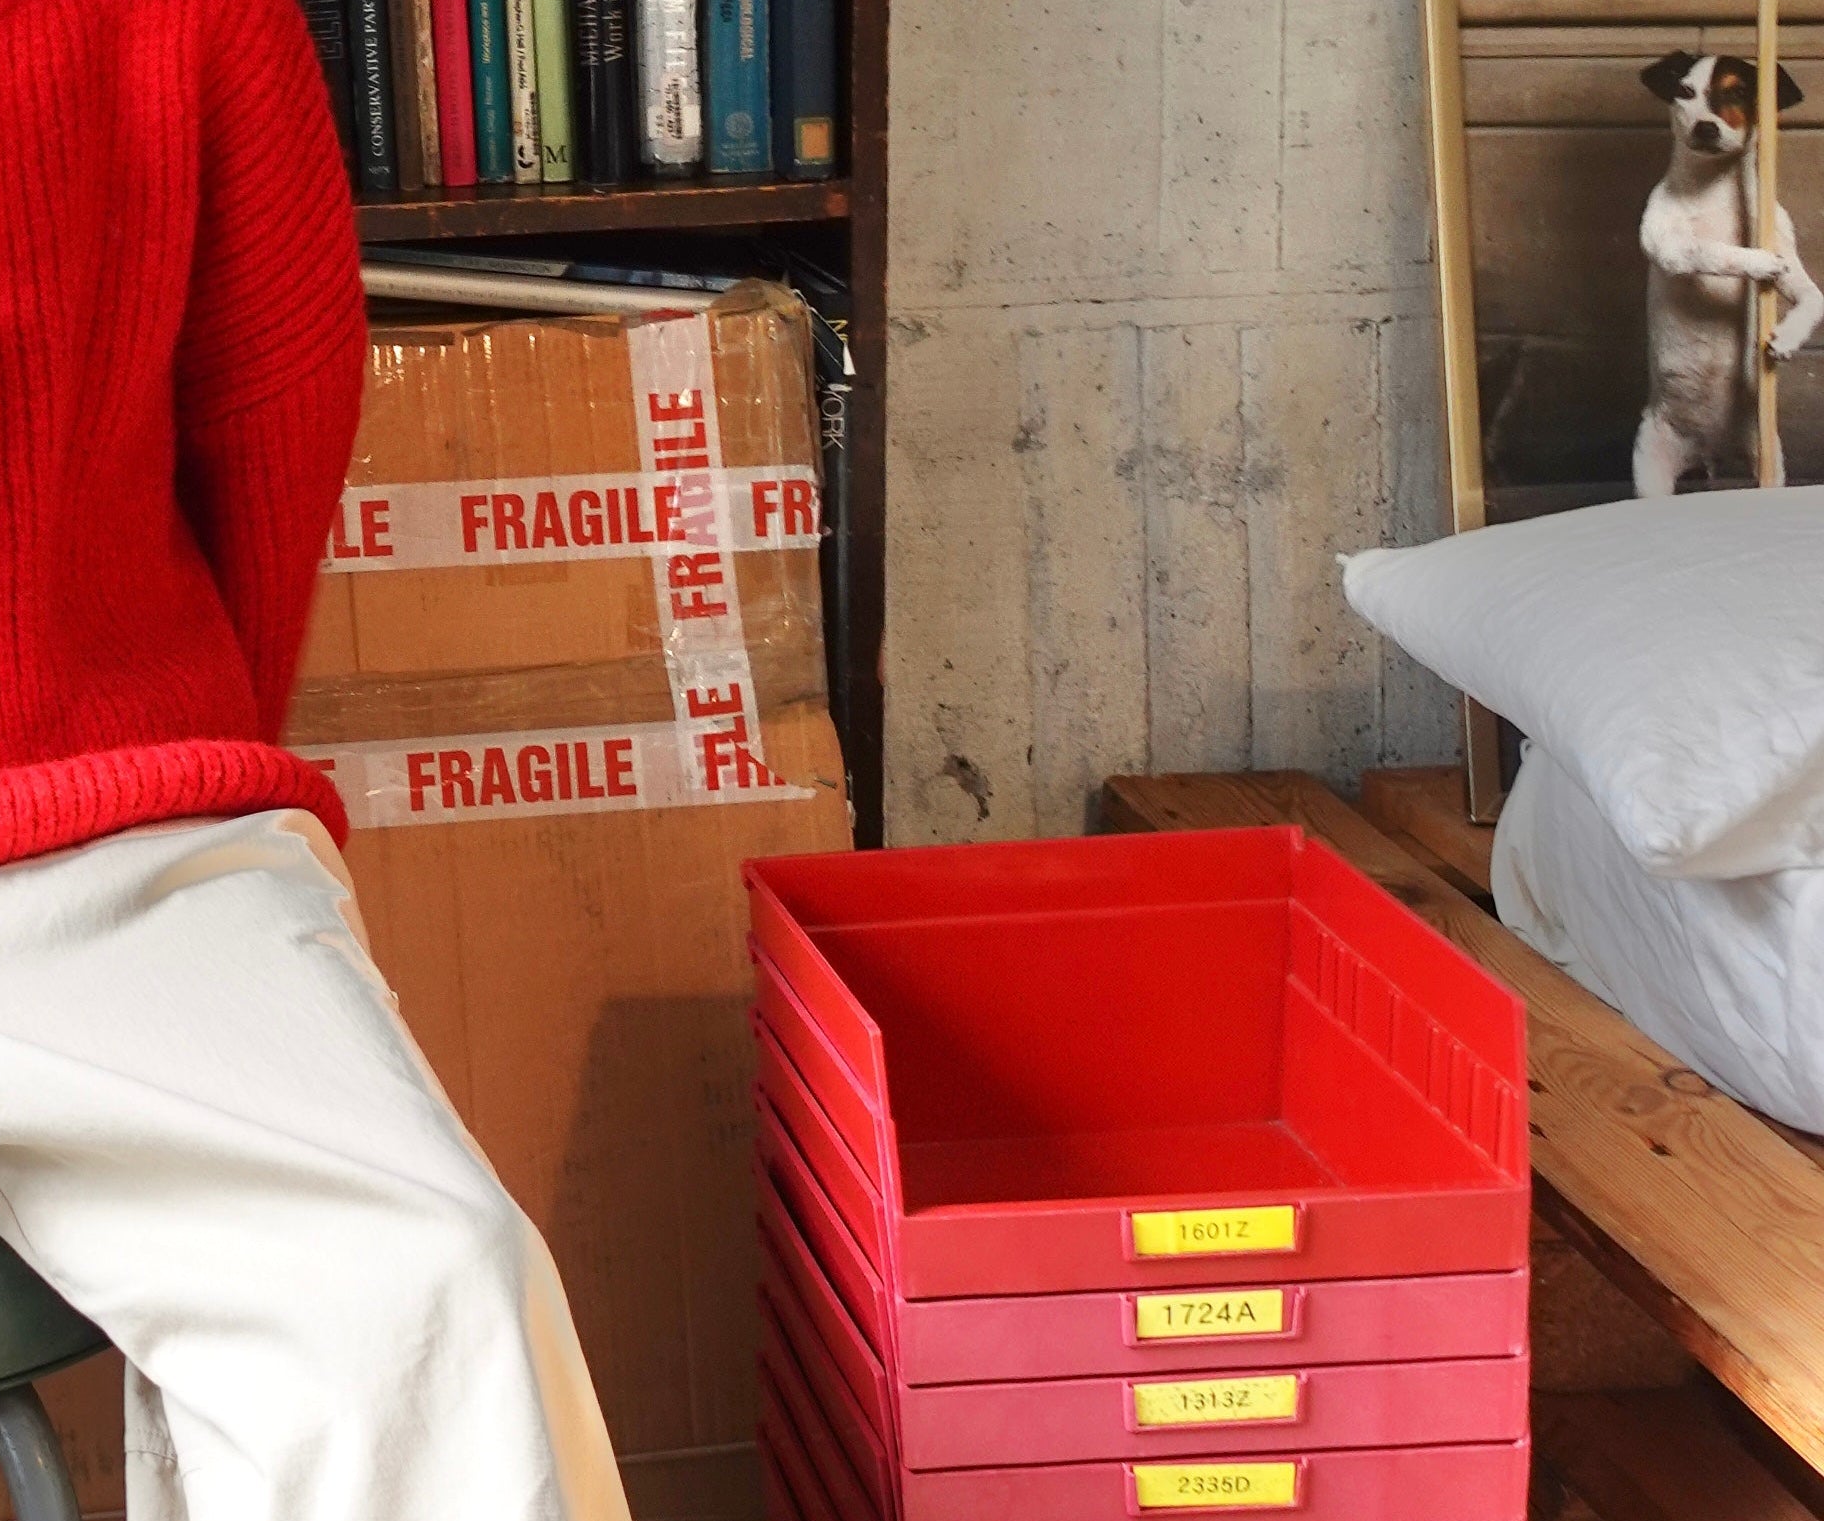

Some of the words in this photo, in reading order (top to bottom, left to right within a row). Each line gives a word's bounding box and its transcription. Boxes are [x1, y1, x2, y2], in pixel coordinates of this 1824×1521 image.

[602, 8, 624, 63] Work
[362, 33, 385, 158] CONSERVATIVE
[460, 484, 687, 553] FRAGILE
[648, 388, 728, 622] FRAGILE
[406, 738, 638, 812] FRAGILE
[1178, 1221, 1250, 1241] 1601Z
[1161, 1302, 1258, 1325] 1724A
[1179, 1390, 1252, 1410] 1313Z
[1177, 1474, 1252, 1494] 2335D
